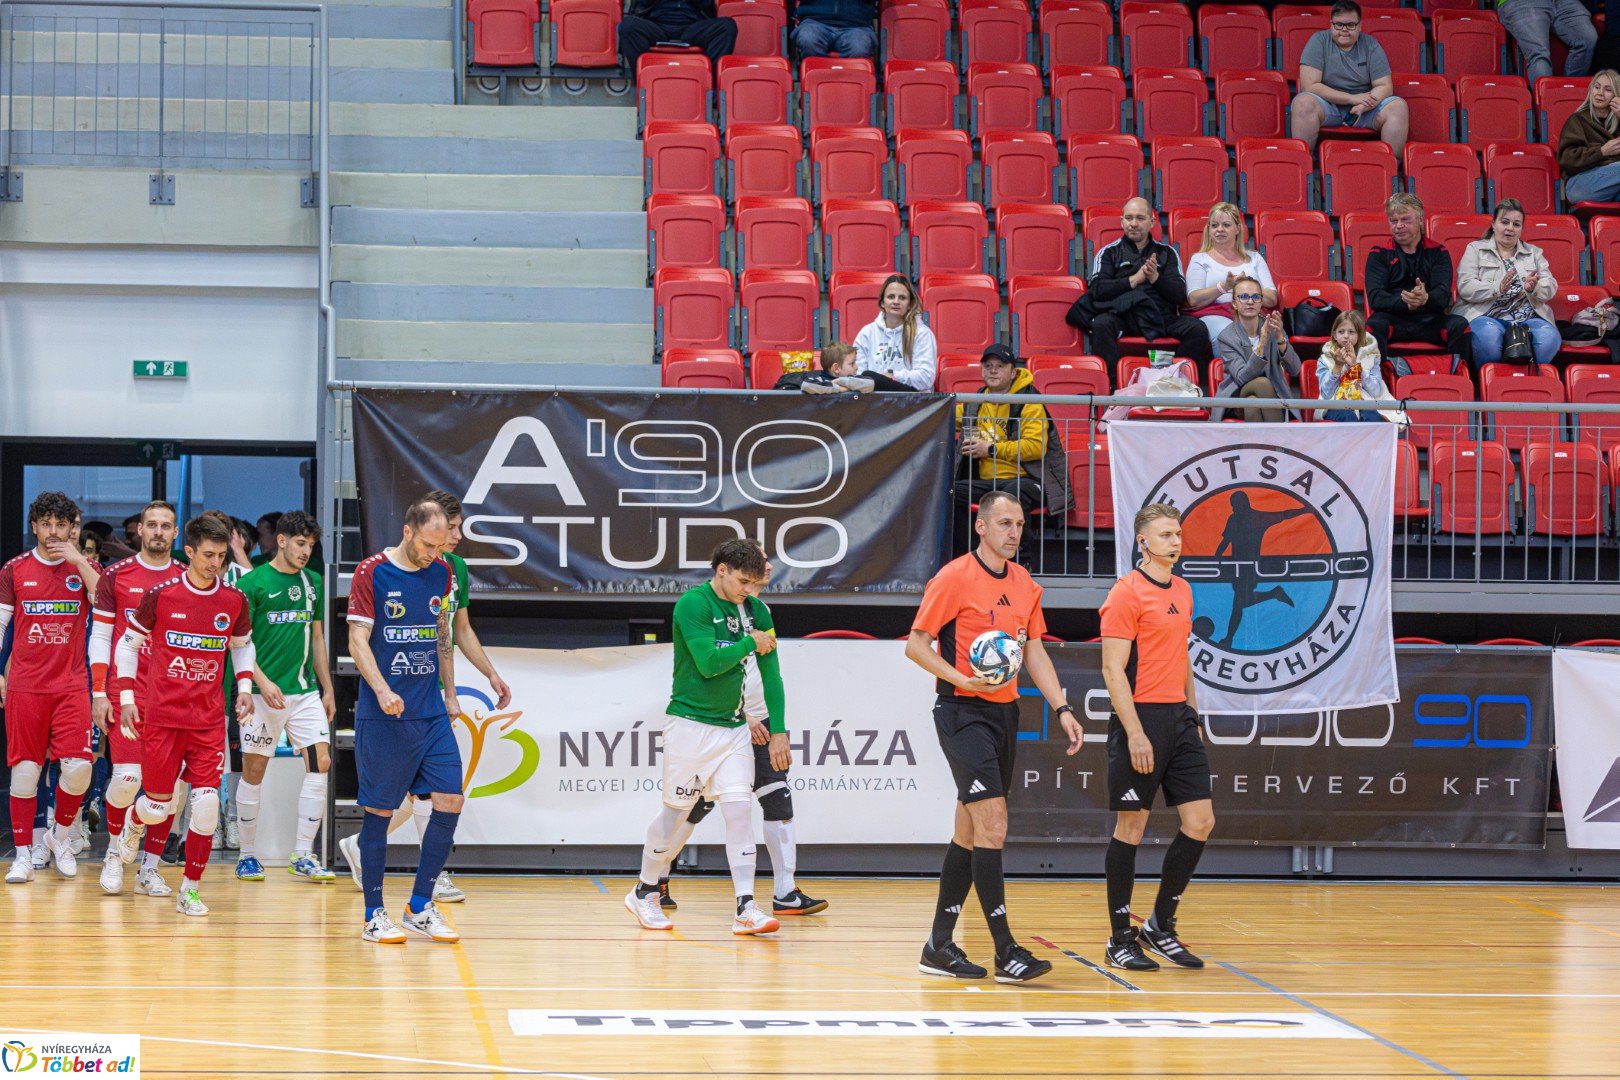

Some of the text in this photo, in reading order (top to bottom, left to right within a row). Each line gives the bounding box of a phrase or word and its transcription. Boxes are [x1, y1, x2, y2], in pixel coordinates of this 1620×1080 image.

[462, 415, 849, 509] A'90
[462, 516, 849, 569] STUDIO
[166, 668, 217, 682] STUDIO
[1412, 693, 1533, 749] 90
[558, 778, 626, 792] MEGYEI
[1442, 777, 1522, 796] KFT
